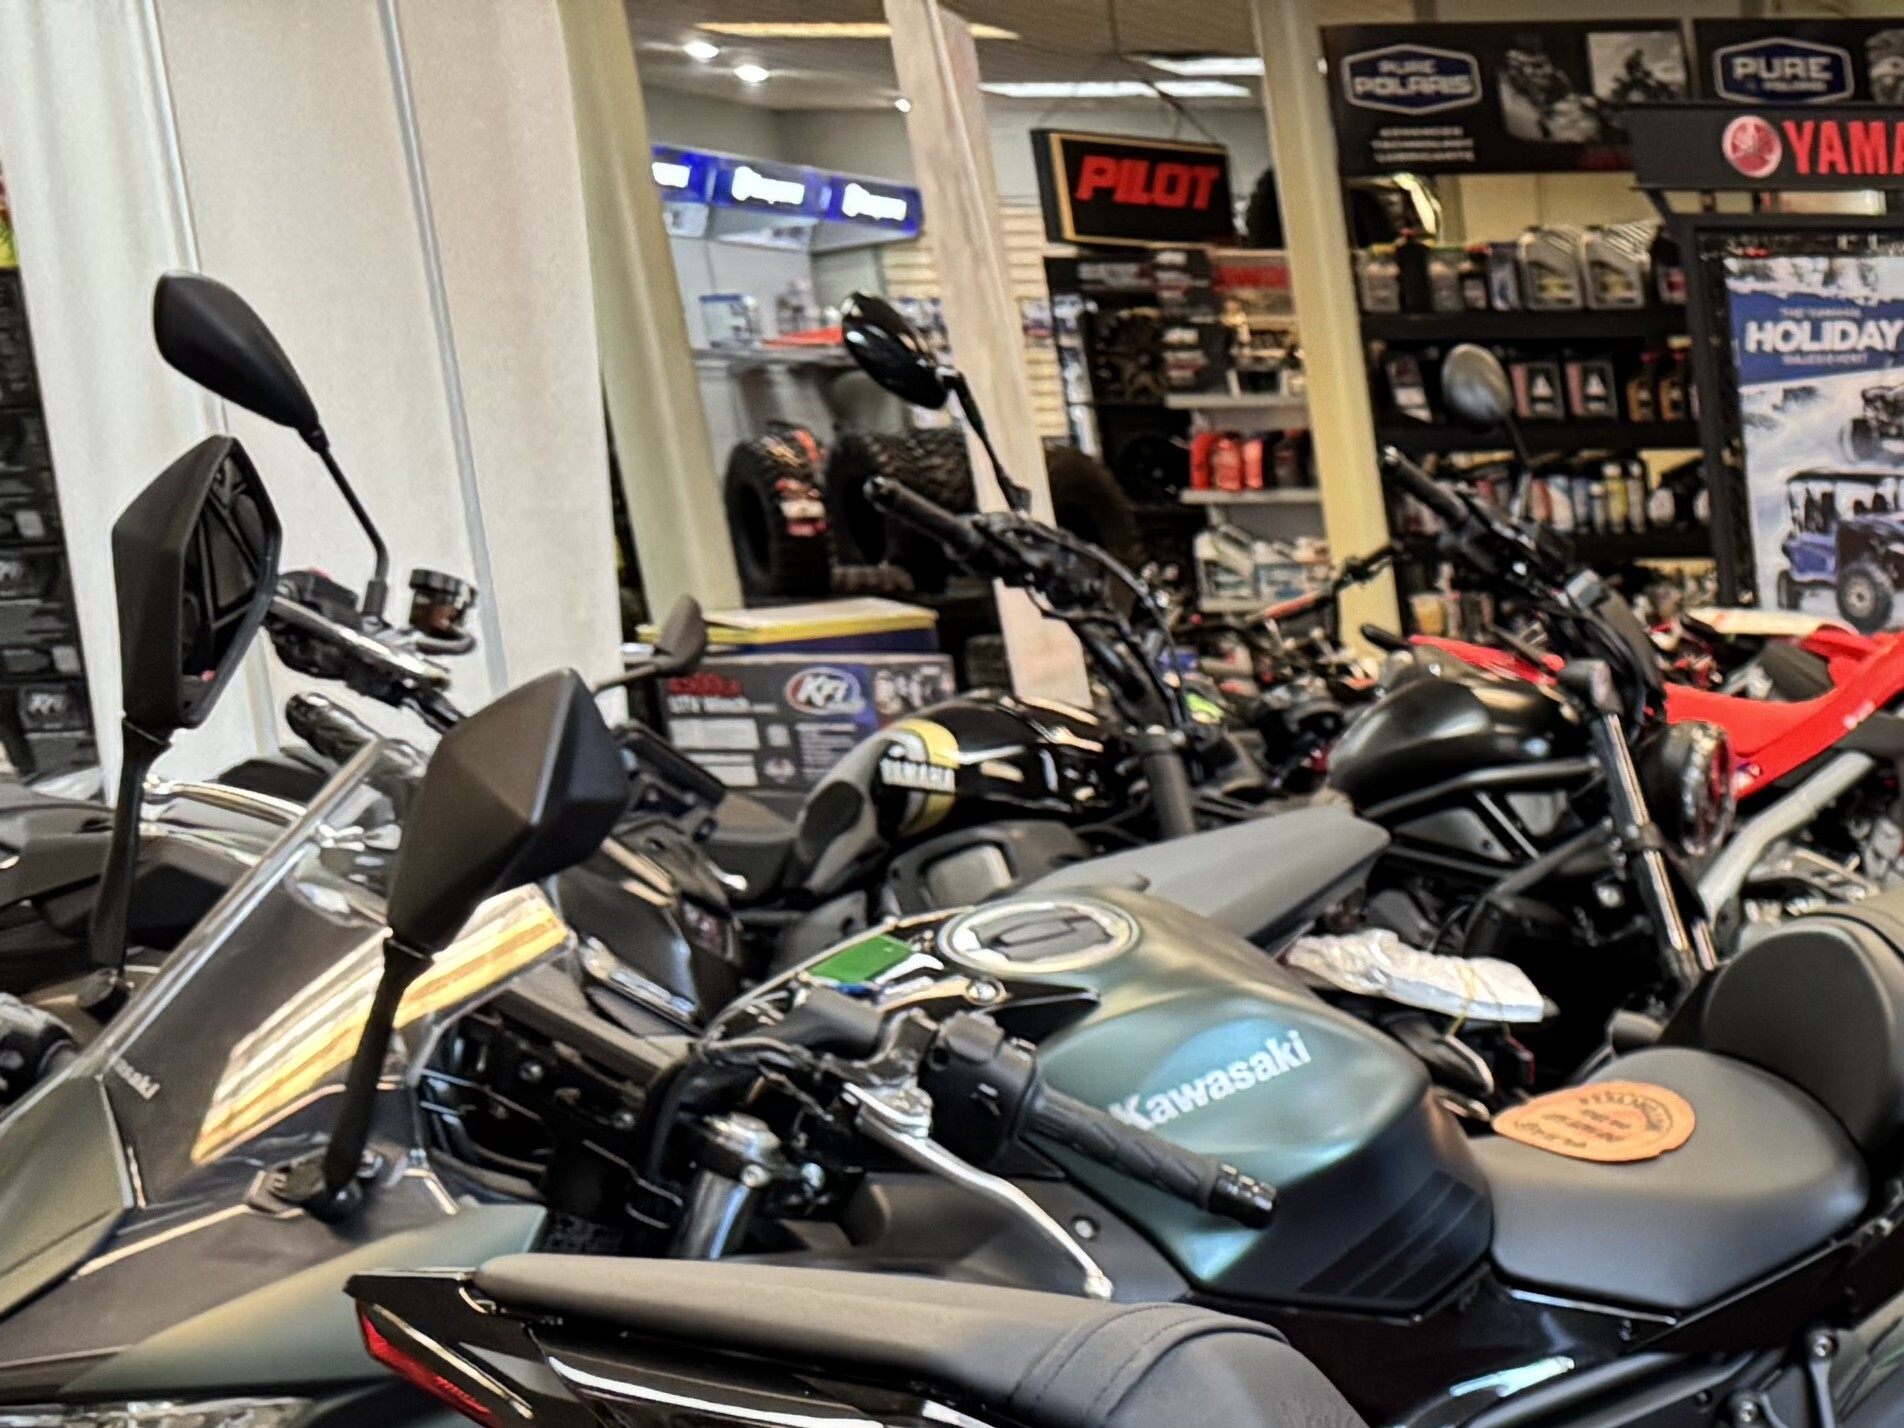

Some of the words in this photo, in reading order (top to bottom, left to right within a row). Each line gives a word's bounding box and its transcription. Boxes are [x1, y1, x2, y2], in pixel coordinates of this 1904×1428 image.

[1732, 56, 1834, 81] PURE
[1353, 75, 1472, 96] POLARIS
[1075, 155, 1220, 210] PILOT
[1745, 320, 1904, 353] HOLIDAY
[1110, 1030, 1311, 1132] Kawasaki
